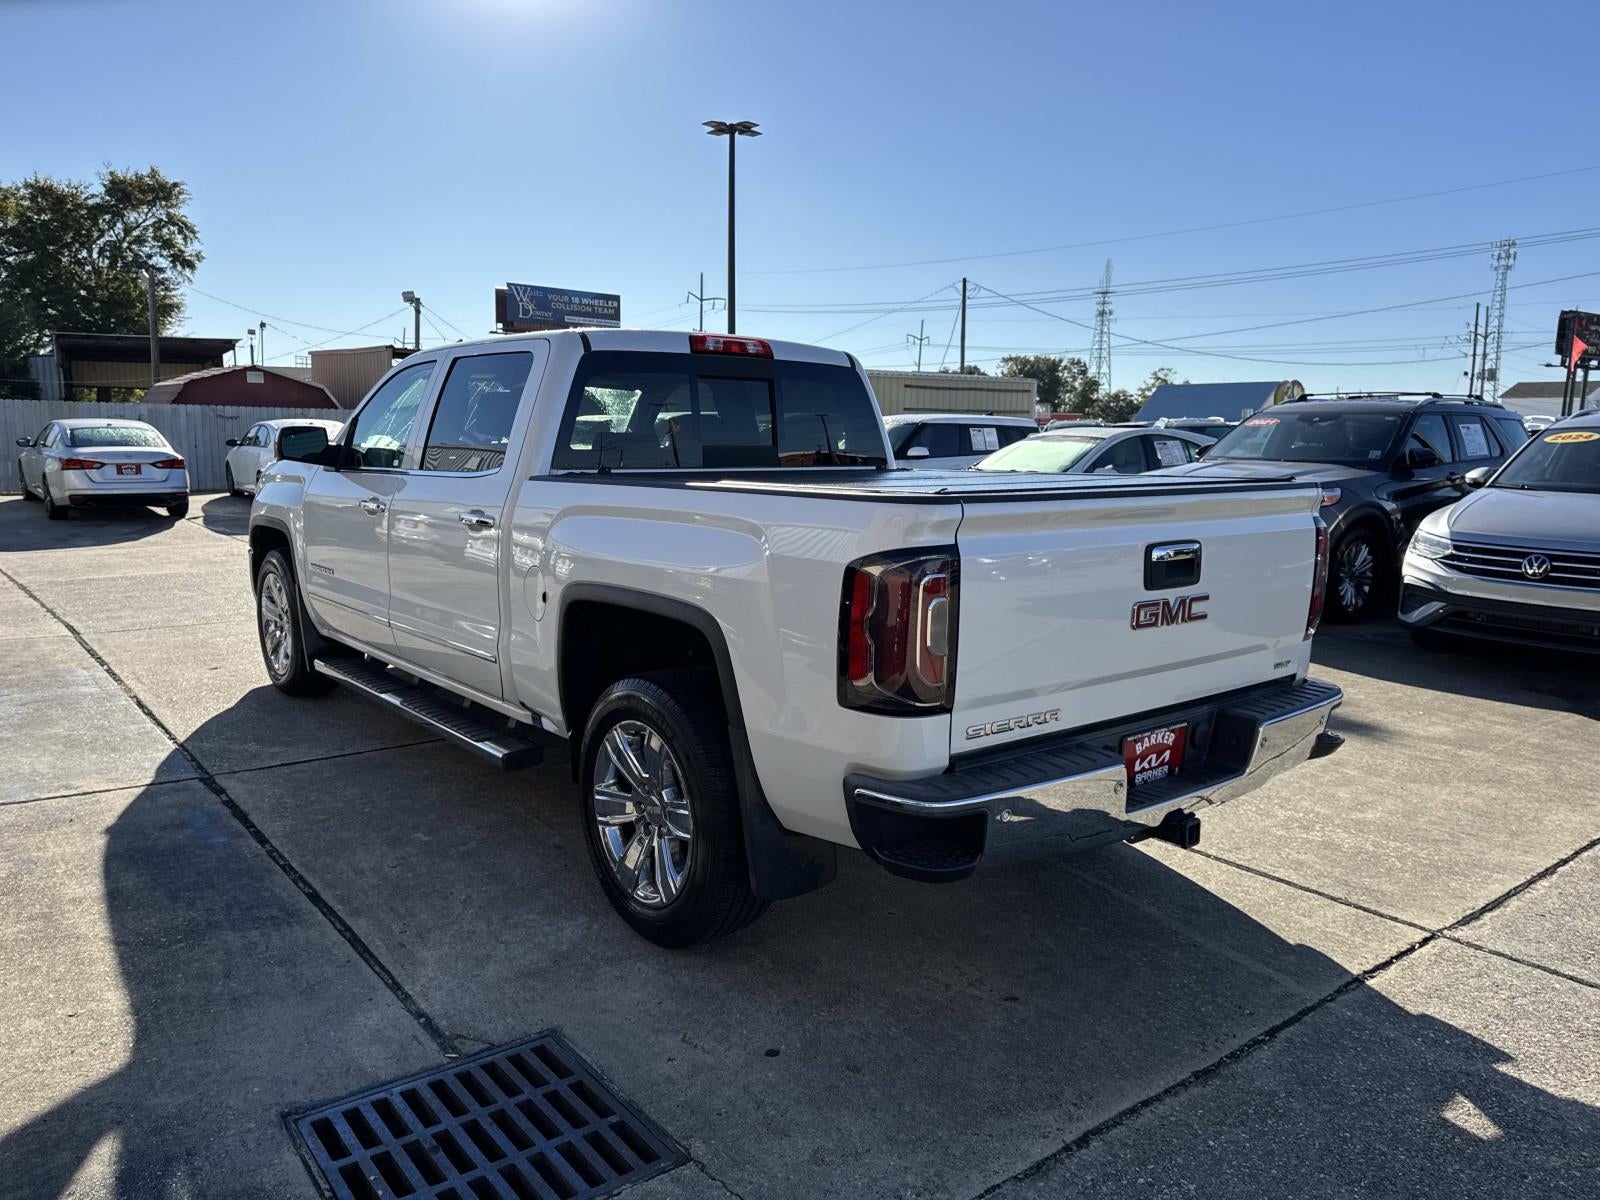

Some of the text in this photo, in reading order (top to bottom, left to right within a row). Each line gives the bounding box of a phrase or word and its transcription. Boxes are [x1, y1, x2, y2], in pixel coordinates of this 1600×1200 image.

[548, 294, 619, 308] YOUR 18 WHEELER
[551, 302, 616, 315] COLLISION TEAM
[1130, 592, 1210, 631] GMC
[965, 708, 1062, 740] SIERRA
[1135, 731, 1176, 755] BARKER
[1134, 749, 1171, 772] KIA
